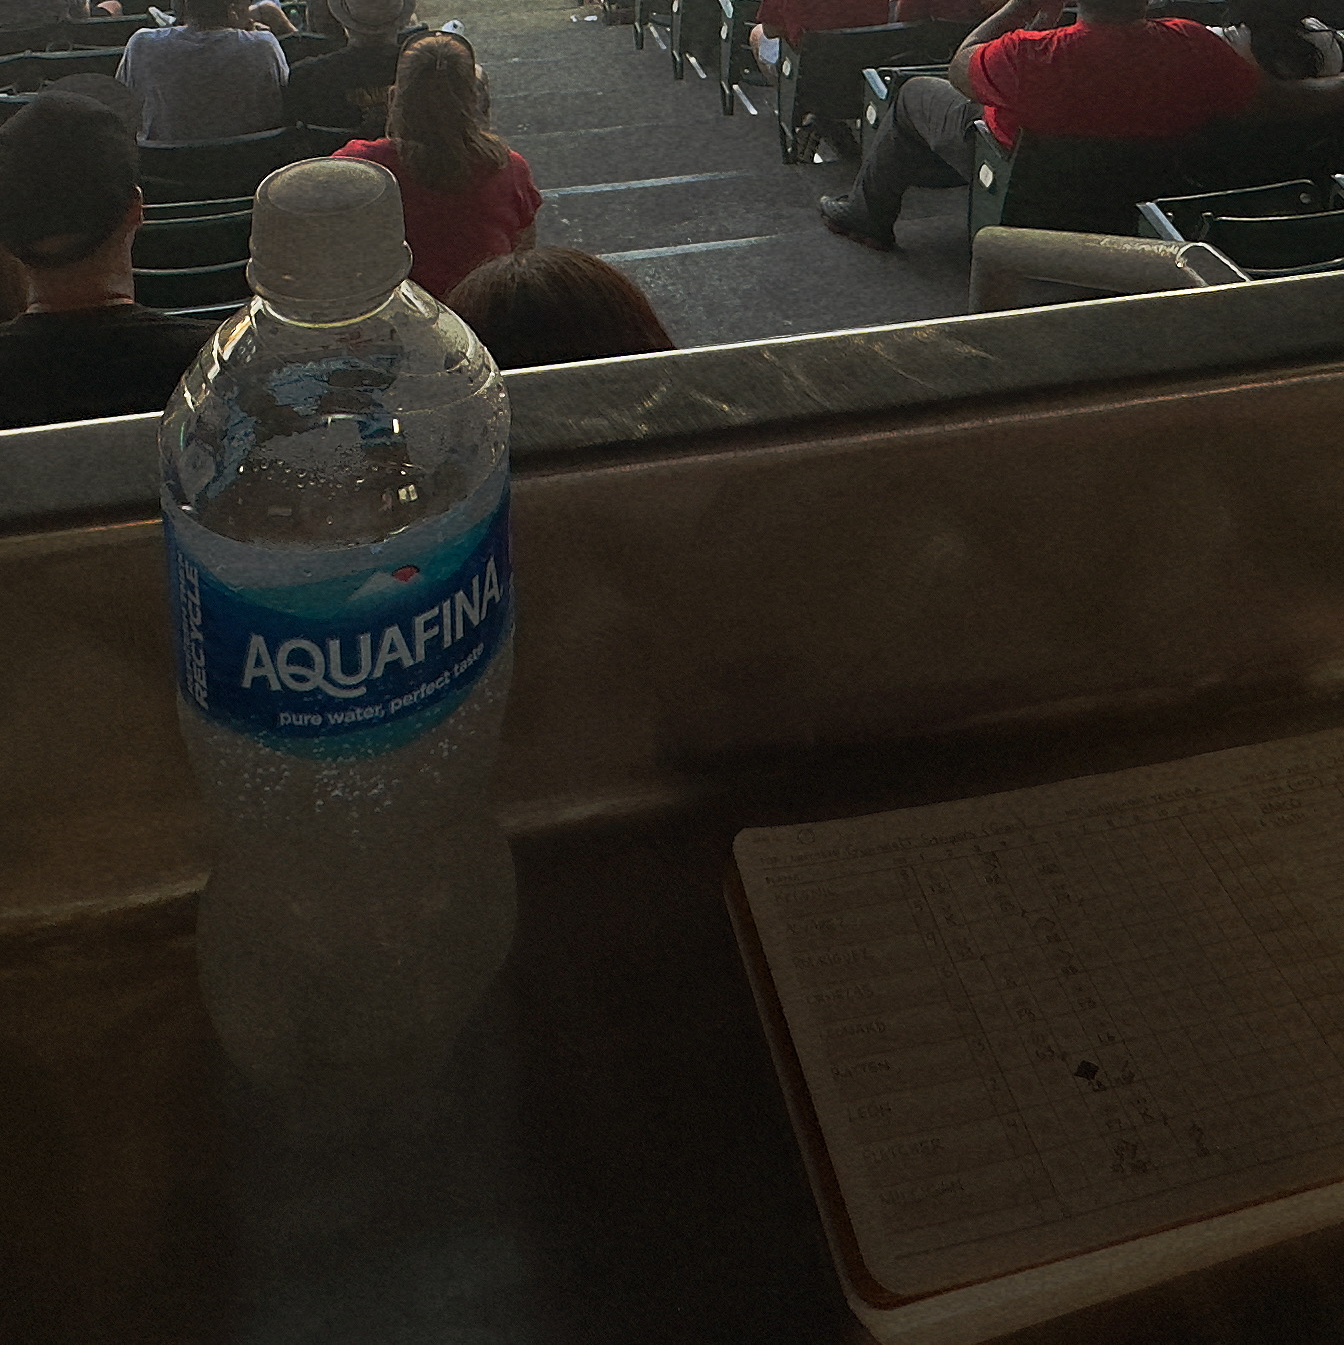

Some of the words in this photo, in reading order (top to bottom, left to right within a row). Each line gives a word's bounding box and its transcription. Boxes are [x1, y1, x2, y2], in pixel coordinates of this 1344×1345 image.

[186, 562, 210, 712] RECYCLE
[240, 554, 504, 699] AQUAFINA
[278, 710, 323, 728] pure
[328, 703, 386, 725] water,
[390, 666, 452, 715] perfect
[453, 641, 485, 676] taste
